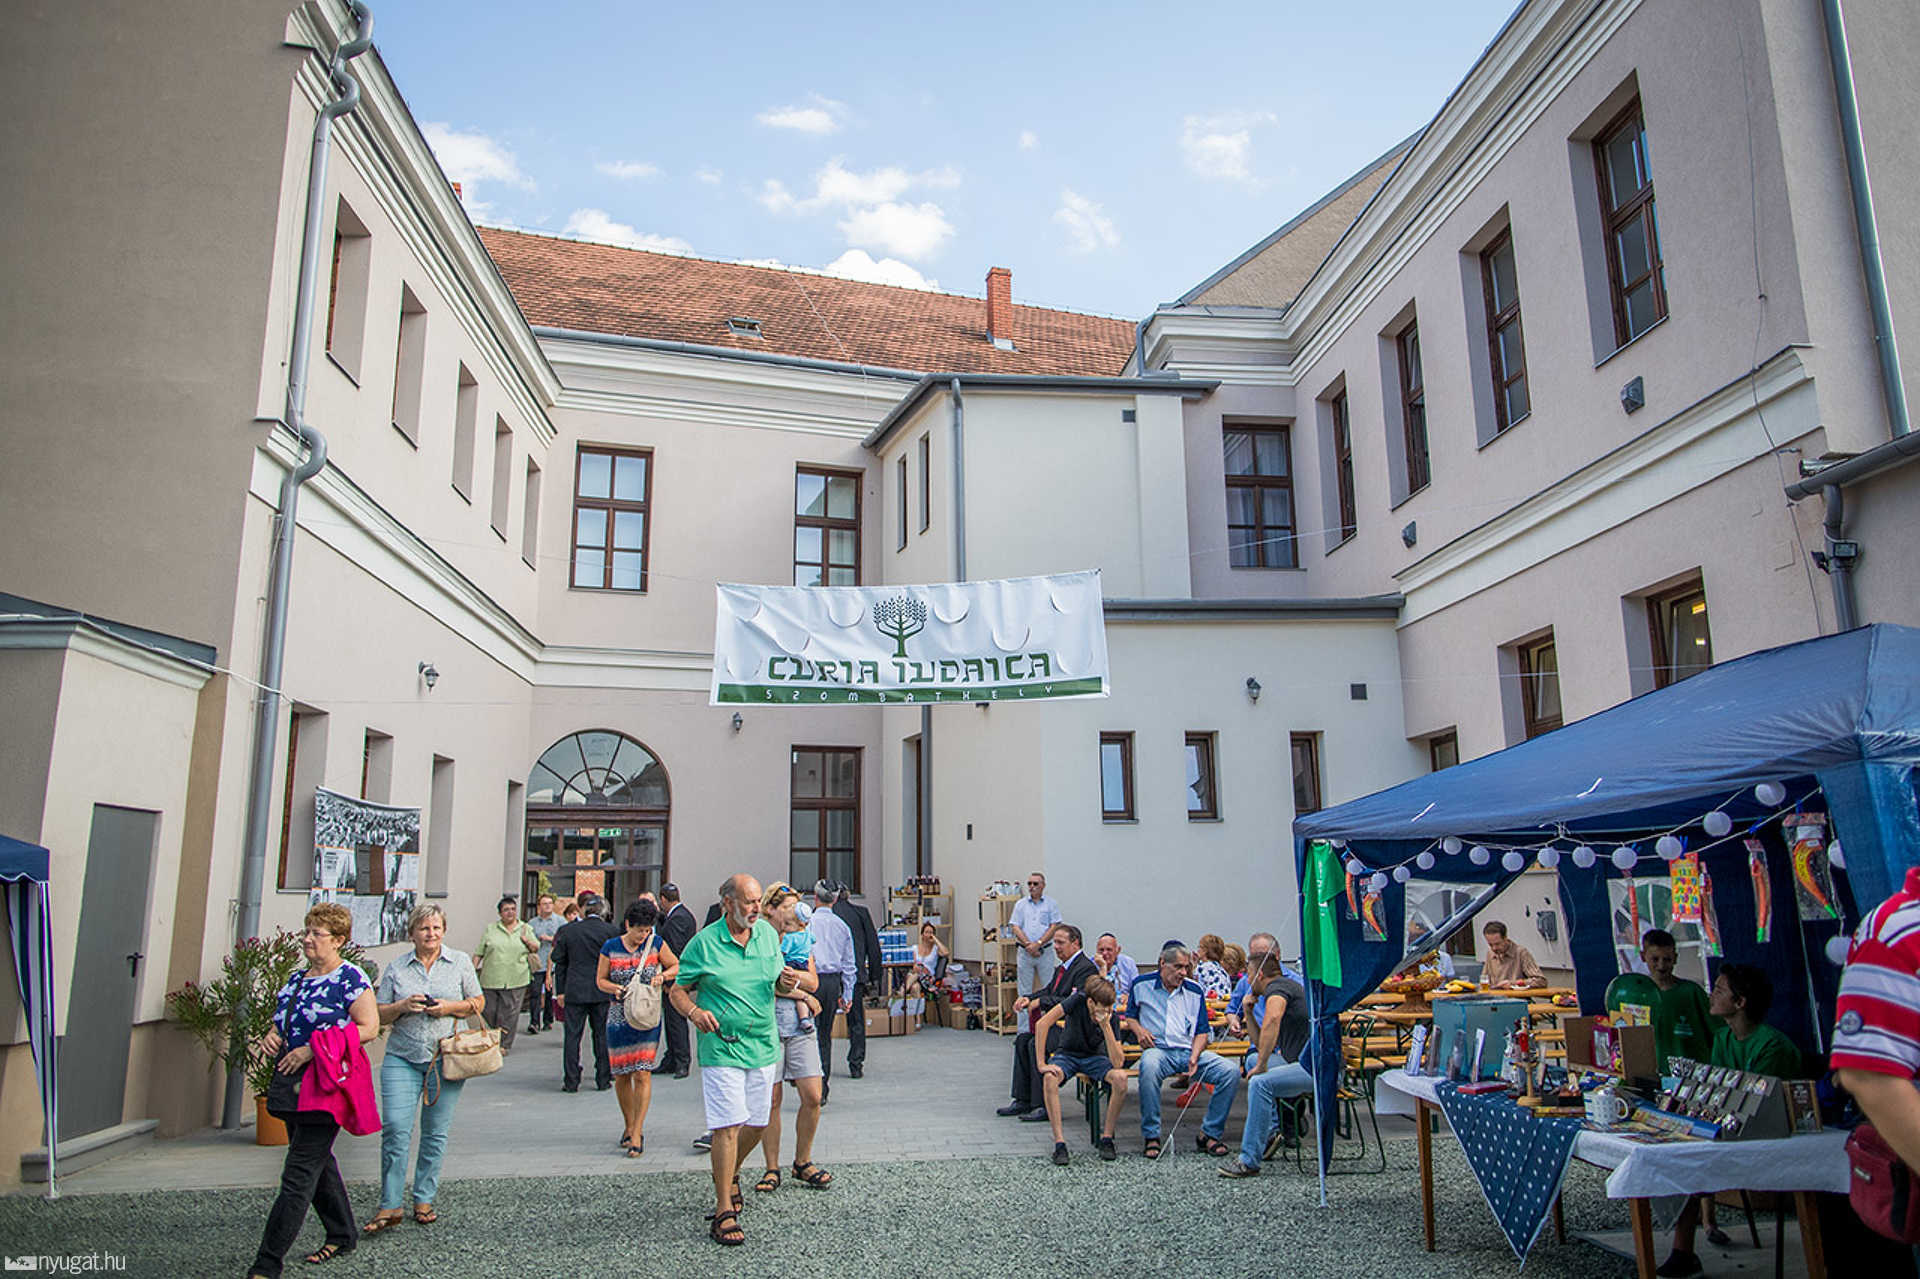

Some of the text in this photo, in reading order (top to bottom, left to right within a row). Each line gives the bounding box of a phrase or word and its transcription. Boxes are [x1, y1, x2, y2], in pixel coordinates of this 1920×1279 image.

[768, 653, 1050, 684] CURIA IUDAICA
[765, 685, 1052, 703] SZOMBATHELY
